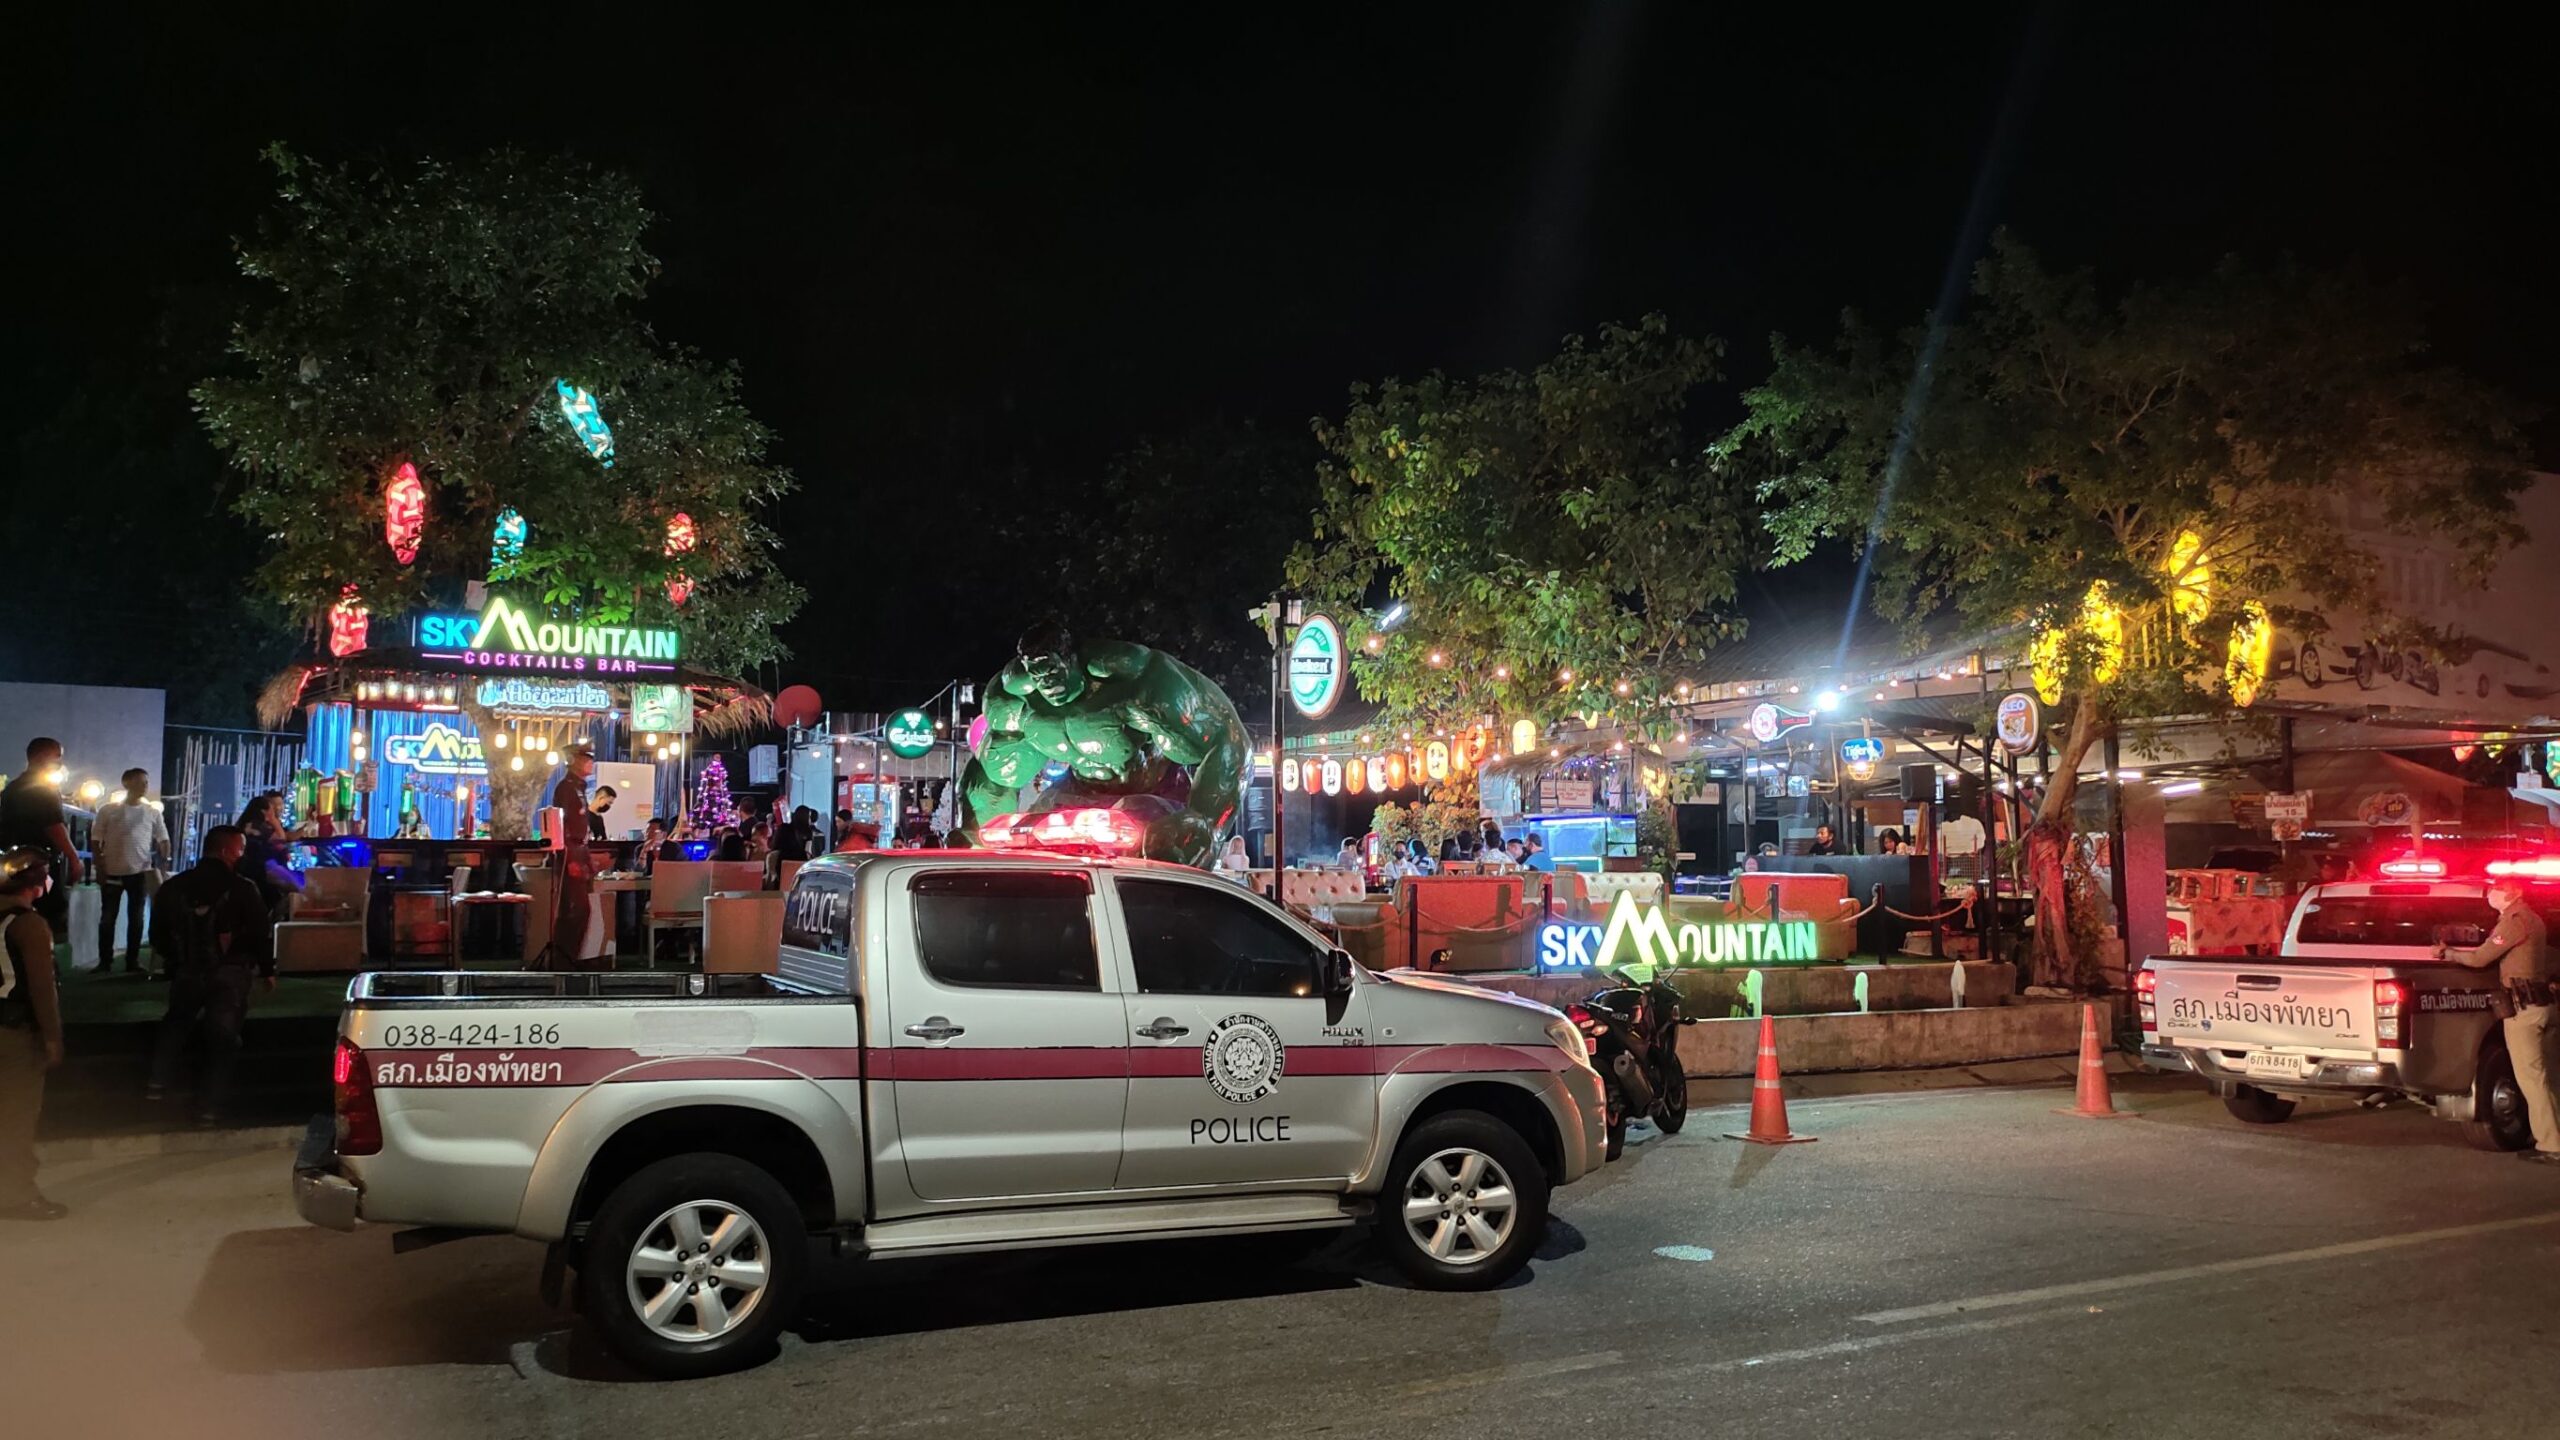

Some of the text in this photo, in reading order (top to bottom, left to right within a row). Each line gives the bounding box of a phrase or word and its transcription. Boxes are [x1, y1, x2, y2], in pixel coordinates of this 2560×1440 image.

[464, 651, 637, 673] COCKTAILS BAR
[507, 683, 608, 706] Hoegaarden
[2003, 699, 2026, 712] LEO
[1845, 744, 1868, 761] Tiger
[796, 891, 839, 935] POLICE
[2172, 989, 2352, 1029] สภ.เมืองพัทยา
[384, 1023, 560, 1048] 038-424-186
[1321, 1022, 1364, 1037] HILUX
[377, 1052, 562, 1084] สภ.เมืองพัทยา
[1204, 1042, 1257, 1102] ROYAL THAI POLICE
[1190, 1115, 1291, 1145] POLICE
